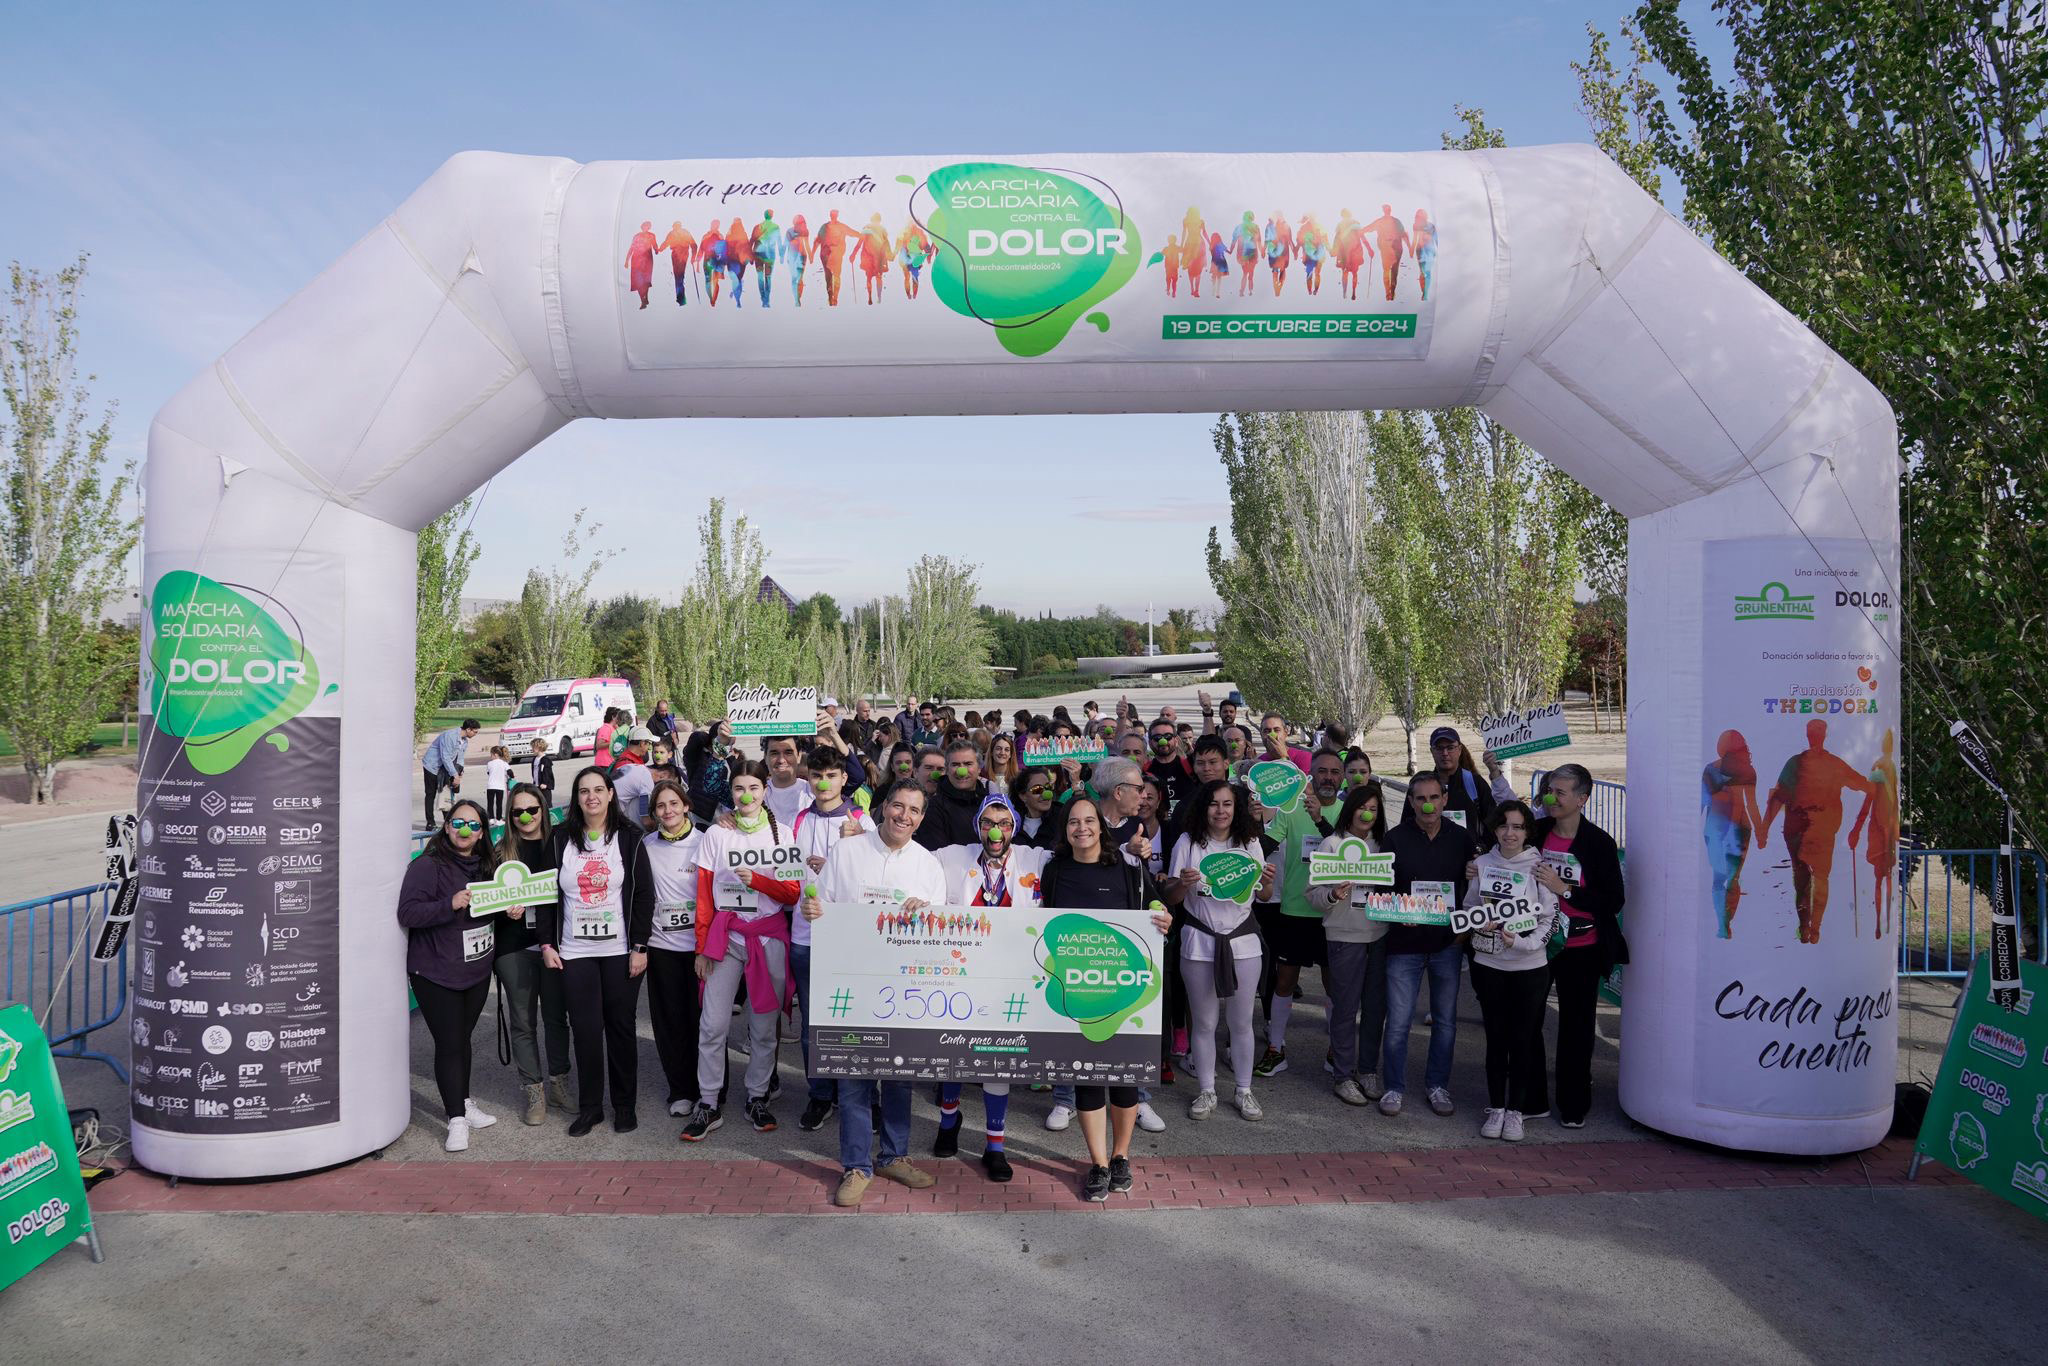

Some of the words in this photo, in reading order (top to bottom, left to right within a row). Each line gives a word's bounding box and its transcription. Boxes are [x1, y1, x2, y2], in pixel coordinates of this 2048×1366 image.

[645, 179, 715, 199] Cada
[721, 179, 784, 205] paso
[794, 174, 877, 196] cuenta
[951, 179, 1059, 192] MARCHA
[951, 194, 1080, 209] SOLIDARIA
[1010, 213, 1062, 223] CONTRA
[1065, 213, 1081, 222] EL
[968, 228, 1129, 257] DOLOR
[969, 262, 1061, 271] #marchacontraeldolor24
[1171, 320, 1191, 334] 19
[1196, 320, 1222, 334] DE
[1226, 319, 1321, 333] OCTUBRE
[1325, 319, 1351, 333] DE
[1355, 319, 1408, 333] 2024
[1794, 569, 1812, 577] Una
[1814, 568, 1847, 577] iniciativa
[161, 603, 244, 617] MARCHA
[1734, 602, 1815, 613] GRÜNENTHAL
[1873, 613, 1889, 622] com
[161, 623, 264, 638] SOLIDARIA
[200, 643, 245, 653] CONTRA
[249, 644, 263, 653] EL
[1762, 651, 1803, 660] Donación
[1806, 651, 1840, 660] solidaria
[1848, 652, 1865, 660] favor
[1866, 652, 1873, 660] de
[169, 658, 307, 685] DOLOR
[727, 684, 771, 703] Cada
[777, 687, 816, 707] paso
[1789, 684, 1862, 696] Fundación
[728, 701, 780, 721] cuenta
[1763, 698, 1878, 714] THEODORA
[1481, 710, 1520, 732] Cada
[1526, 703, 1561, 728] paso
[1485, 723, 1532, 749] cuenta
[1265, 774, 1302, 793] DOLOR
[272, 797, 310, 807] GEER
[226, 825, 267, 836] SEDAR
[281, 854, 322, 867] SEMG
[728, 847, 802, 867] DOLOR
[182, 871, 216, 879] SEMDOR
[777, 869, 804, 878] com
[1216, 863, 1258, 885] DOLOR
[1312, 863, 1392, 874] GRÜNENTHAL
[145, 886, 173, 900] SERMEF
[471, 881, 558, 905] GRÜNENTHAL
[1492, 881, 1513, 895] 62
[735, 895, 742, 906] 1
[188, 907, 244, 916] Reumatología
[1368, 912, 1447, 923] #marchacontraeldolor24
[670, 913, 690, 926] 56
[1507, 919, 1535, 932] com
[272, 927, 300, 940] SCD
[581, 923, 609, 935] 111
[472, 935, 492, 953] 112
[886, 937, 921, 946] Páguese
[923, 938, 941, 946] este
[943, 938, 972, 947] cheque
[1056, 933, 1118, 944] MARCHA
[1056, 946, 1129, 957] SOLIDARIA
[299, 961, 318, 969] Galega
[900, 966, 968, 976] THEODORA
[1065, 968, 1154, 987] DOLOR
[181, 1000, 209, 1014] SMD
[231, 1003, 264, 1015] SMD
[873, 986, 973, 1021] 3.500
[1715, 980, 1823, 1029] Cada
[1834, 988, 1893, 1040] paso
[279, 1027, 326, 1039] Diabetes
[279, 1037, 317, 1049] Madrid
[939, 1033, 966, 1045] Cada
[968, 1037, 993, 1049] paso
[995, 1033, 1027, 1047] cuenta
[1758, 1024, 1872, 1072] cuenta
[238, 1063, 264, 1075] FEP
[287, 1058, 322, 1075] FMF
[201, 1071, 226, 1092] fede
